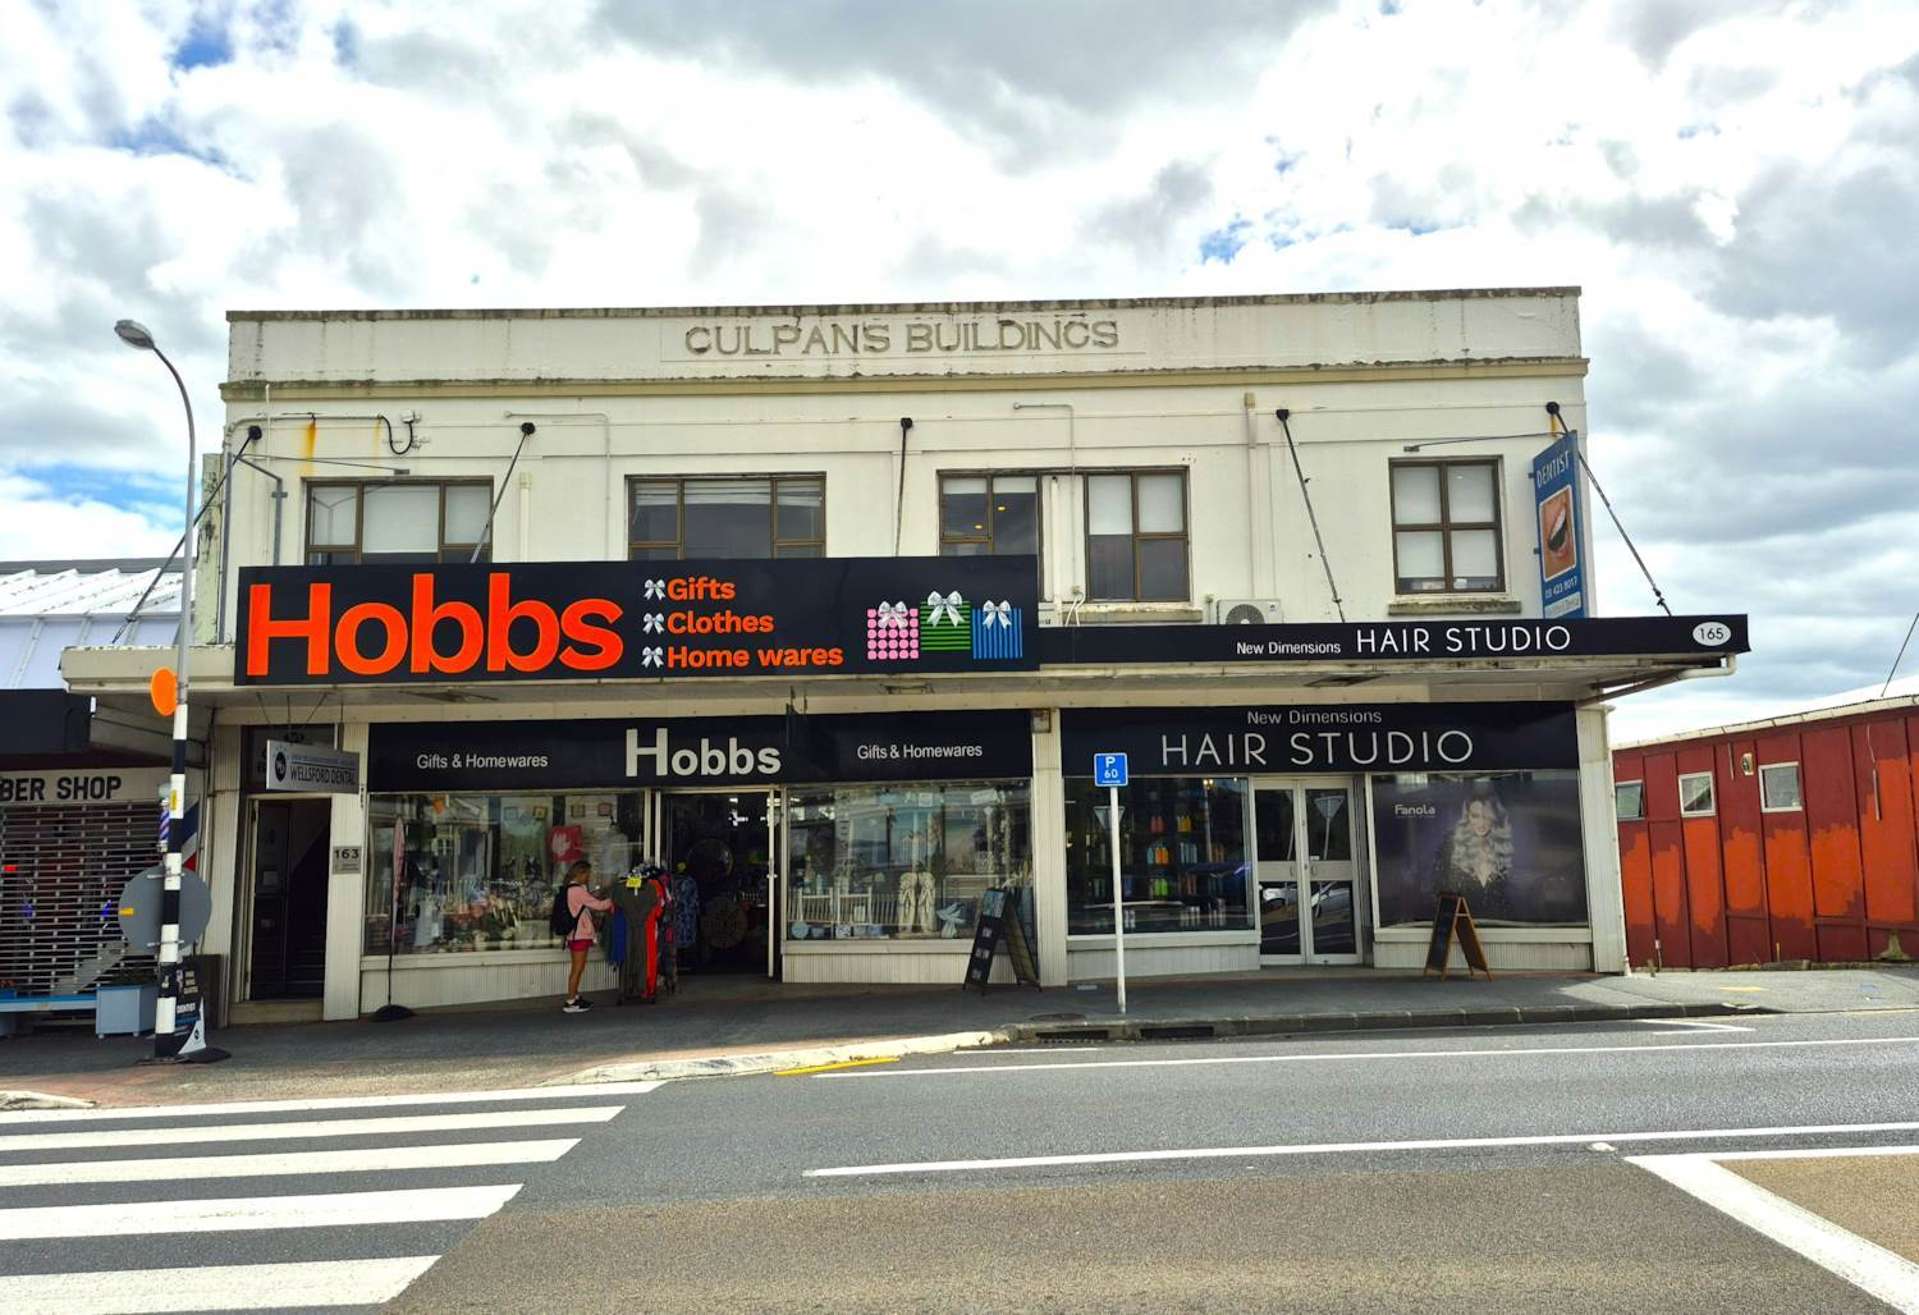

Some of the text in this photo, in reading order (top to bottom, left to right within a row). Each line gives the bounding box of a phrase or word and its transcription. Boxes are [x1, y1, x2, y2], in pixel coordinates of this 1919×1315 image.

[905, 319, 1119, 353] BUILDINGS
[667, 576, 736, 600] Gifts
[247, 573, 624, 676] Hobbs
[667, 610, 775, 635] Clothes
[1356, 626, 1571, 653] HAIR STUDIO
[1700, 628, 1724, 641] 165
[667, 646, 844, 668] Home wares
[1236, 641, 1341, 655] New Dimensions
[1247, 710, 1382, 725] New Dimensions
[625, 728, 782, 777] Hobbs
[857, 744, 983, 759] Gifts & Homewares
[1161, 730, 1473, 765] HAIR STUDIO
[416, 754, 548, 769] Gifts & Homewares
[1105, 756, 1116, 768] P
[1104, 768, 1119, 779] 60
[0, 776, 122, 801] BER SHOP
[1395, 804, 1436, 815] Fanola
[334, 848, 359, 859] 163
